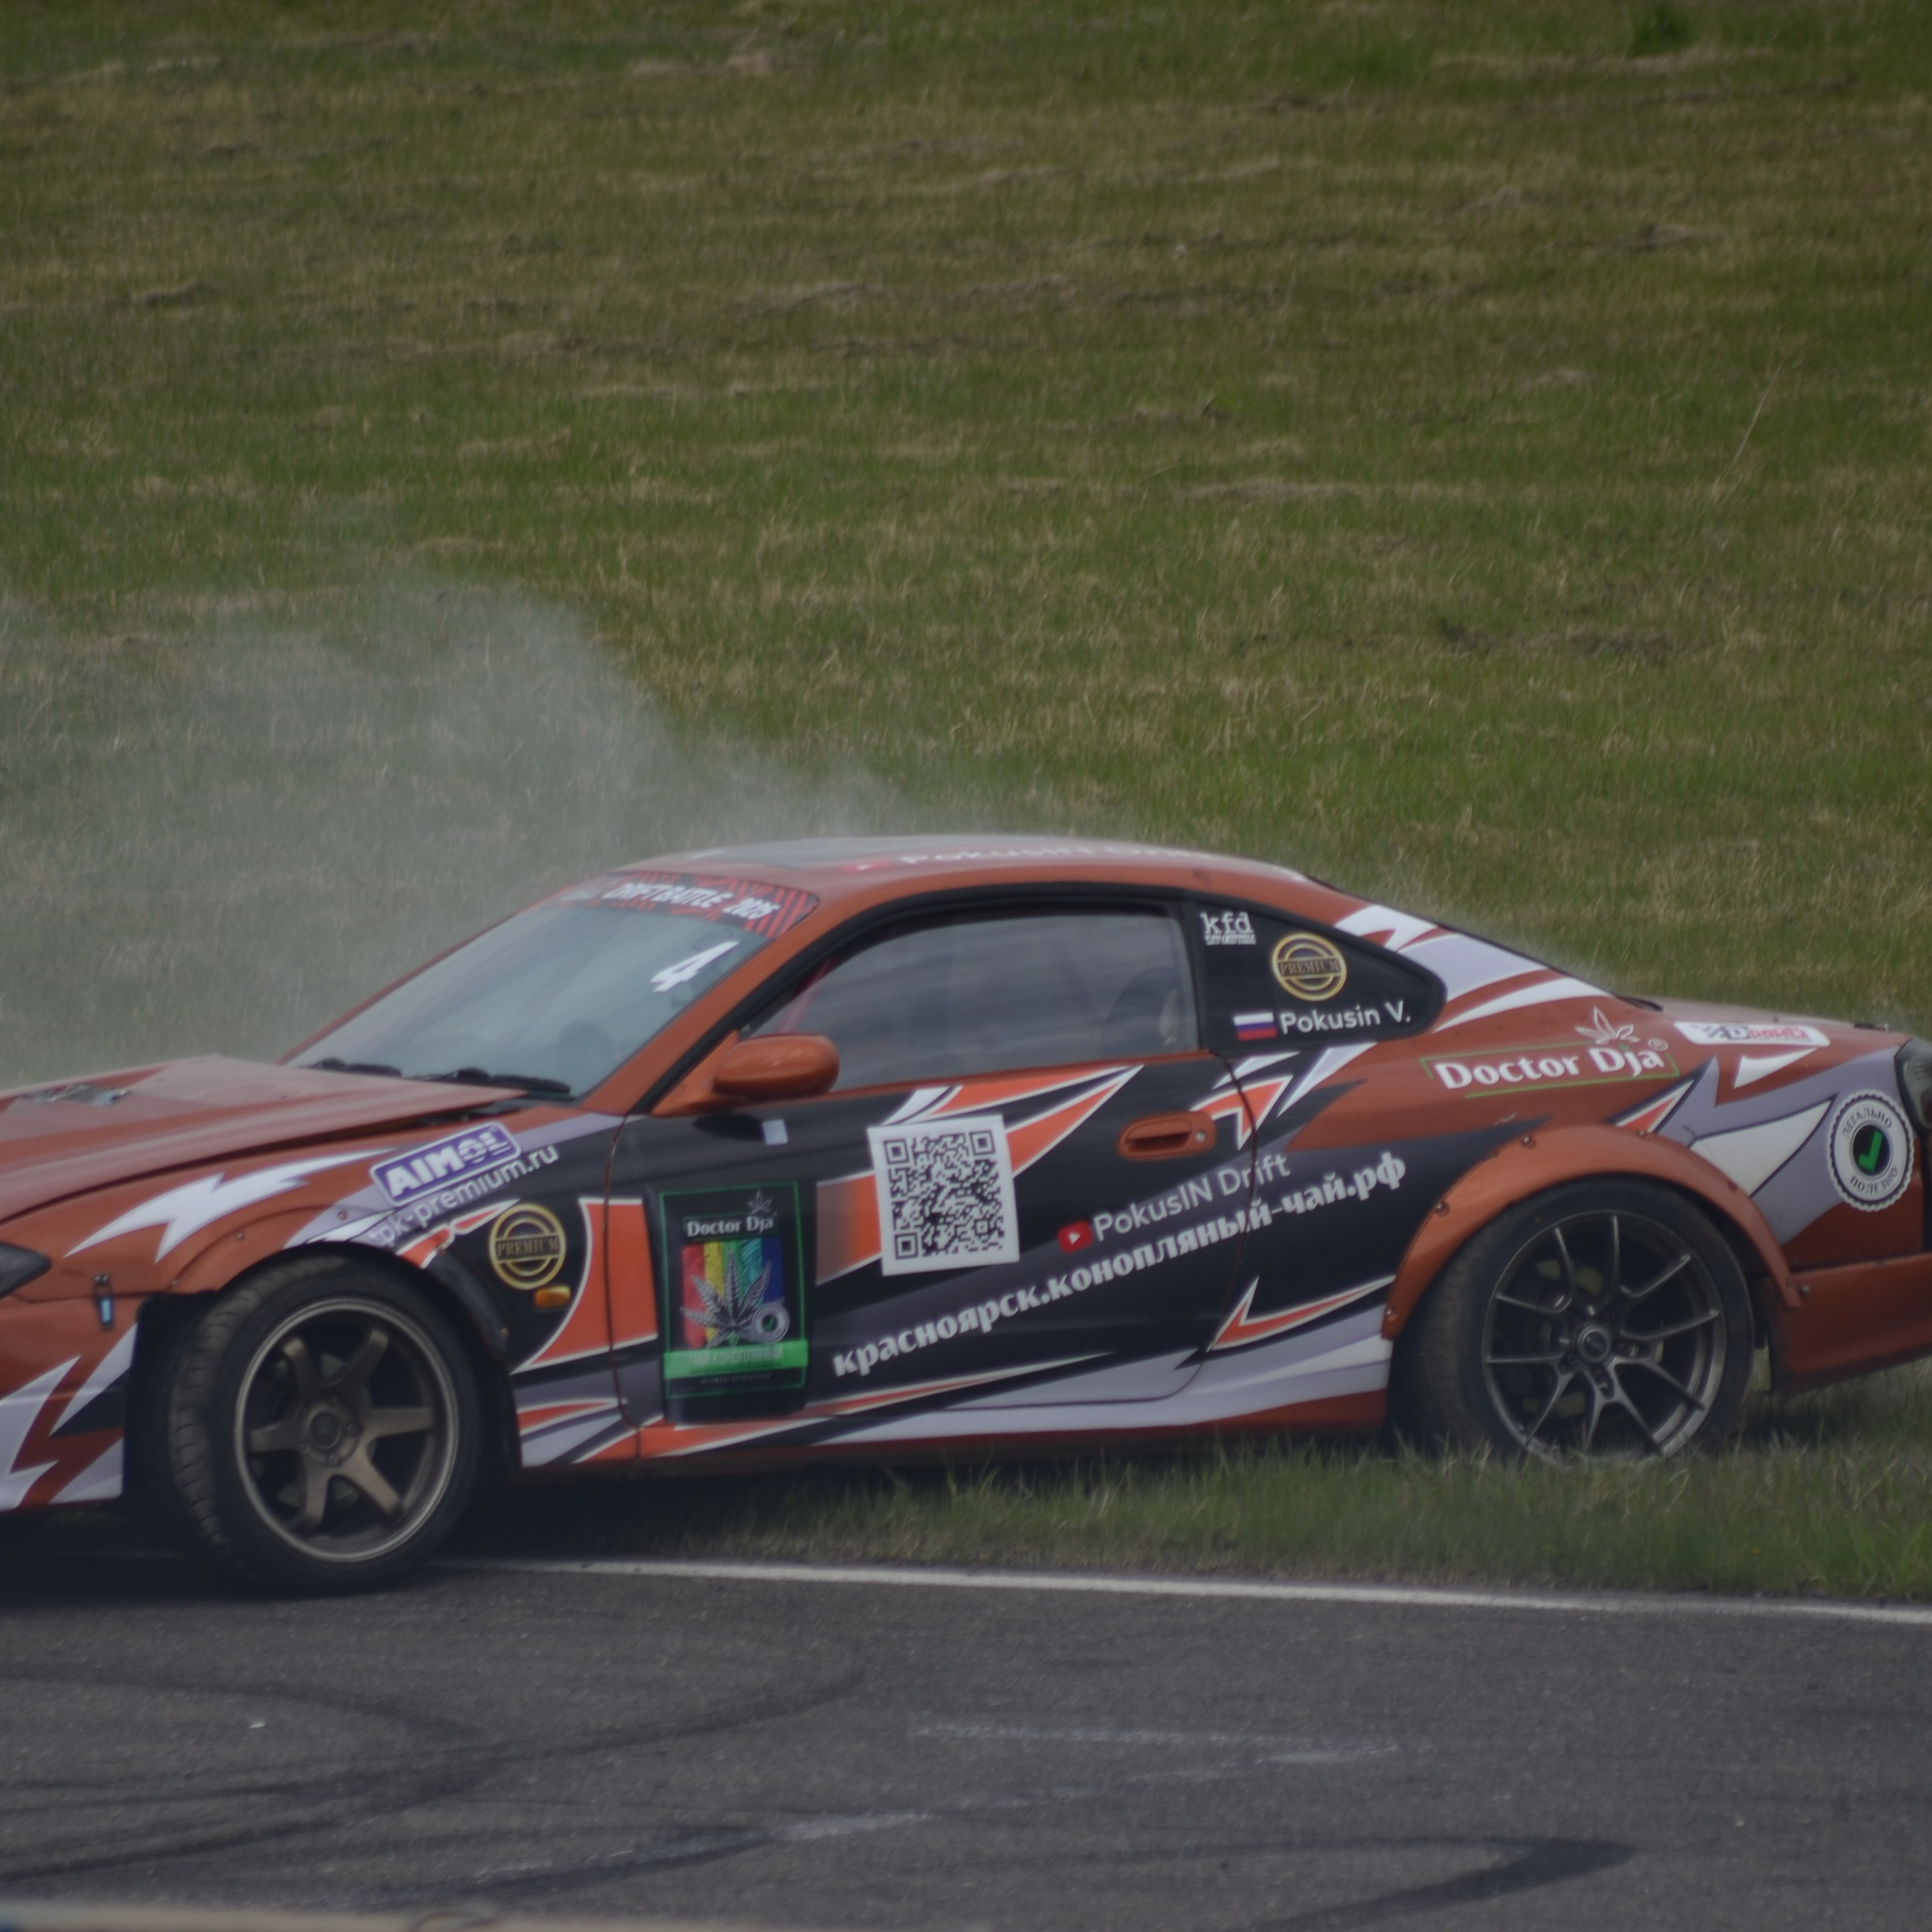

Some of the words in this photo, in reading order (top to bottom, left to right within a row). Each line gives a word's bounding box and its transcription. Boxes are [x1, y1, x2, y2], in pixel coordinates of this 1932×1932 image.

[1200, 911, 1254, 934] kfd
[651, 940, 739, 993] 4
[1279, 958, 1341, 976] PREMIUM
[1280, 1005, 1380, 1035] Pokusin
[1383, 999, 1411, 1023] V.
[1434, 1054, 1580, 1090] Doctor
[1093, 1174, 1213, 1241] PokusIN
[1217, 1152, 1291, 1196] Drift
[497, 1236, 558, 1257] PREMIUM
[686, 1220, 743, 1238] Doctor
[832, 1151, 1406, 1377] красноярск.конопляный-чай.рф
